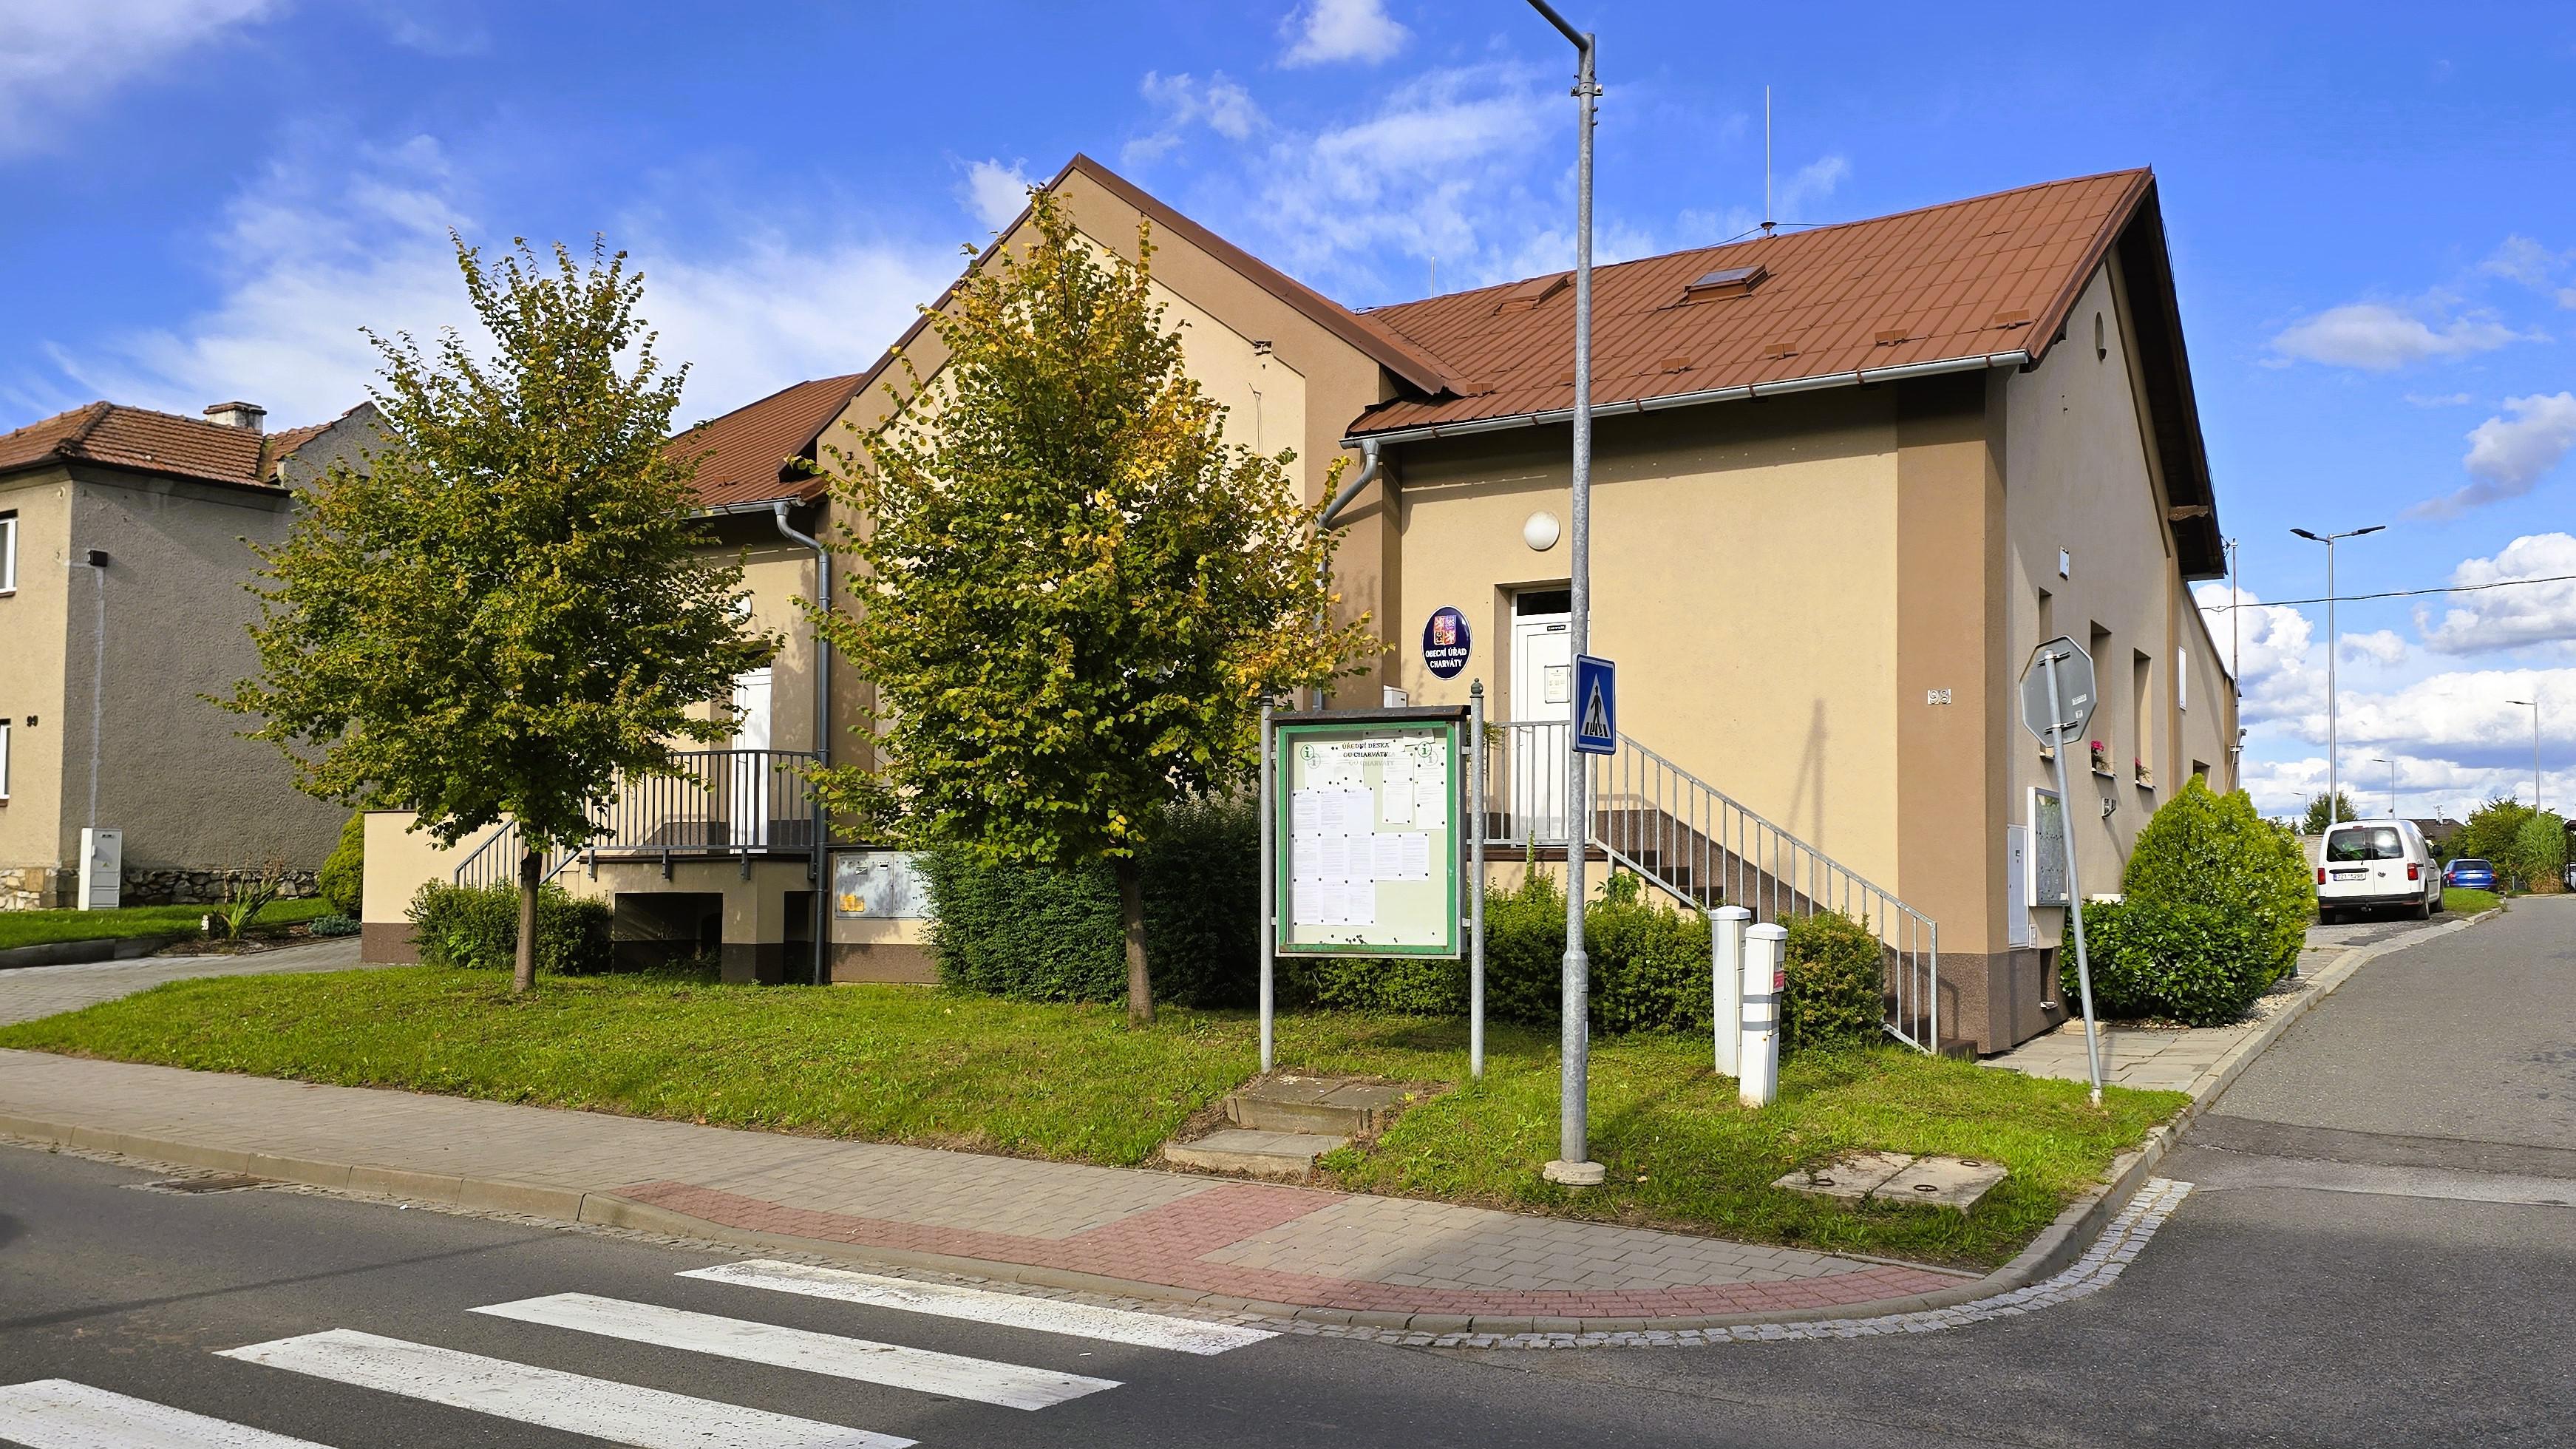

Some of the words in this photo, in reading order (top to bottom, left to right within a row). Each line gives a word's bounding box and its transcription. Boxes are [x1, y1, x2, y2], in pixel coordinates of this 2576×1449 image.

[1425, 647, 1447, 657] OBECNÍ
[1447, 646, 1467, 656] ÚŘAD
[1430, 658, 1463, 668] CHARVÁTY
[1929, 689, 1950, 704] 98
[27, 715, 38, 727] 99
